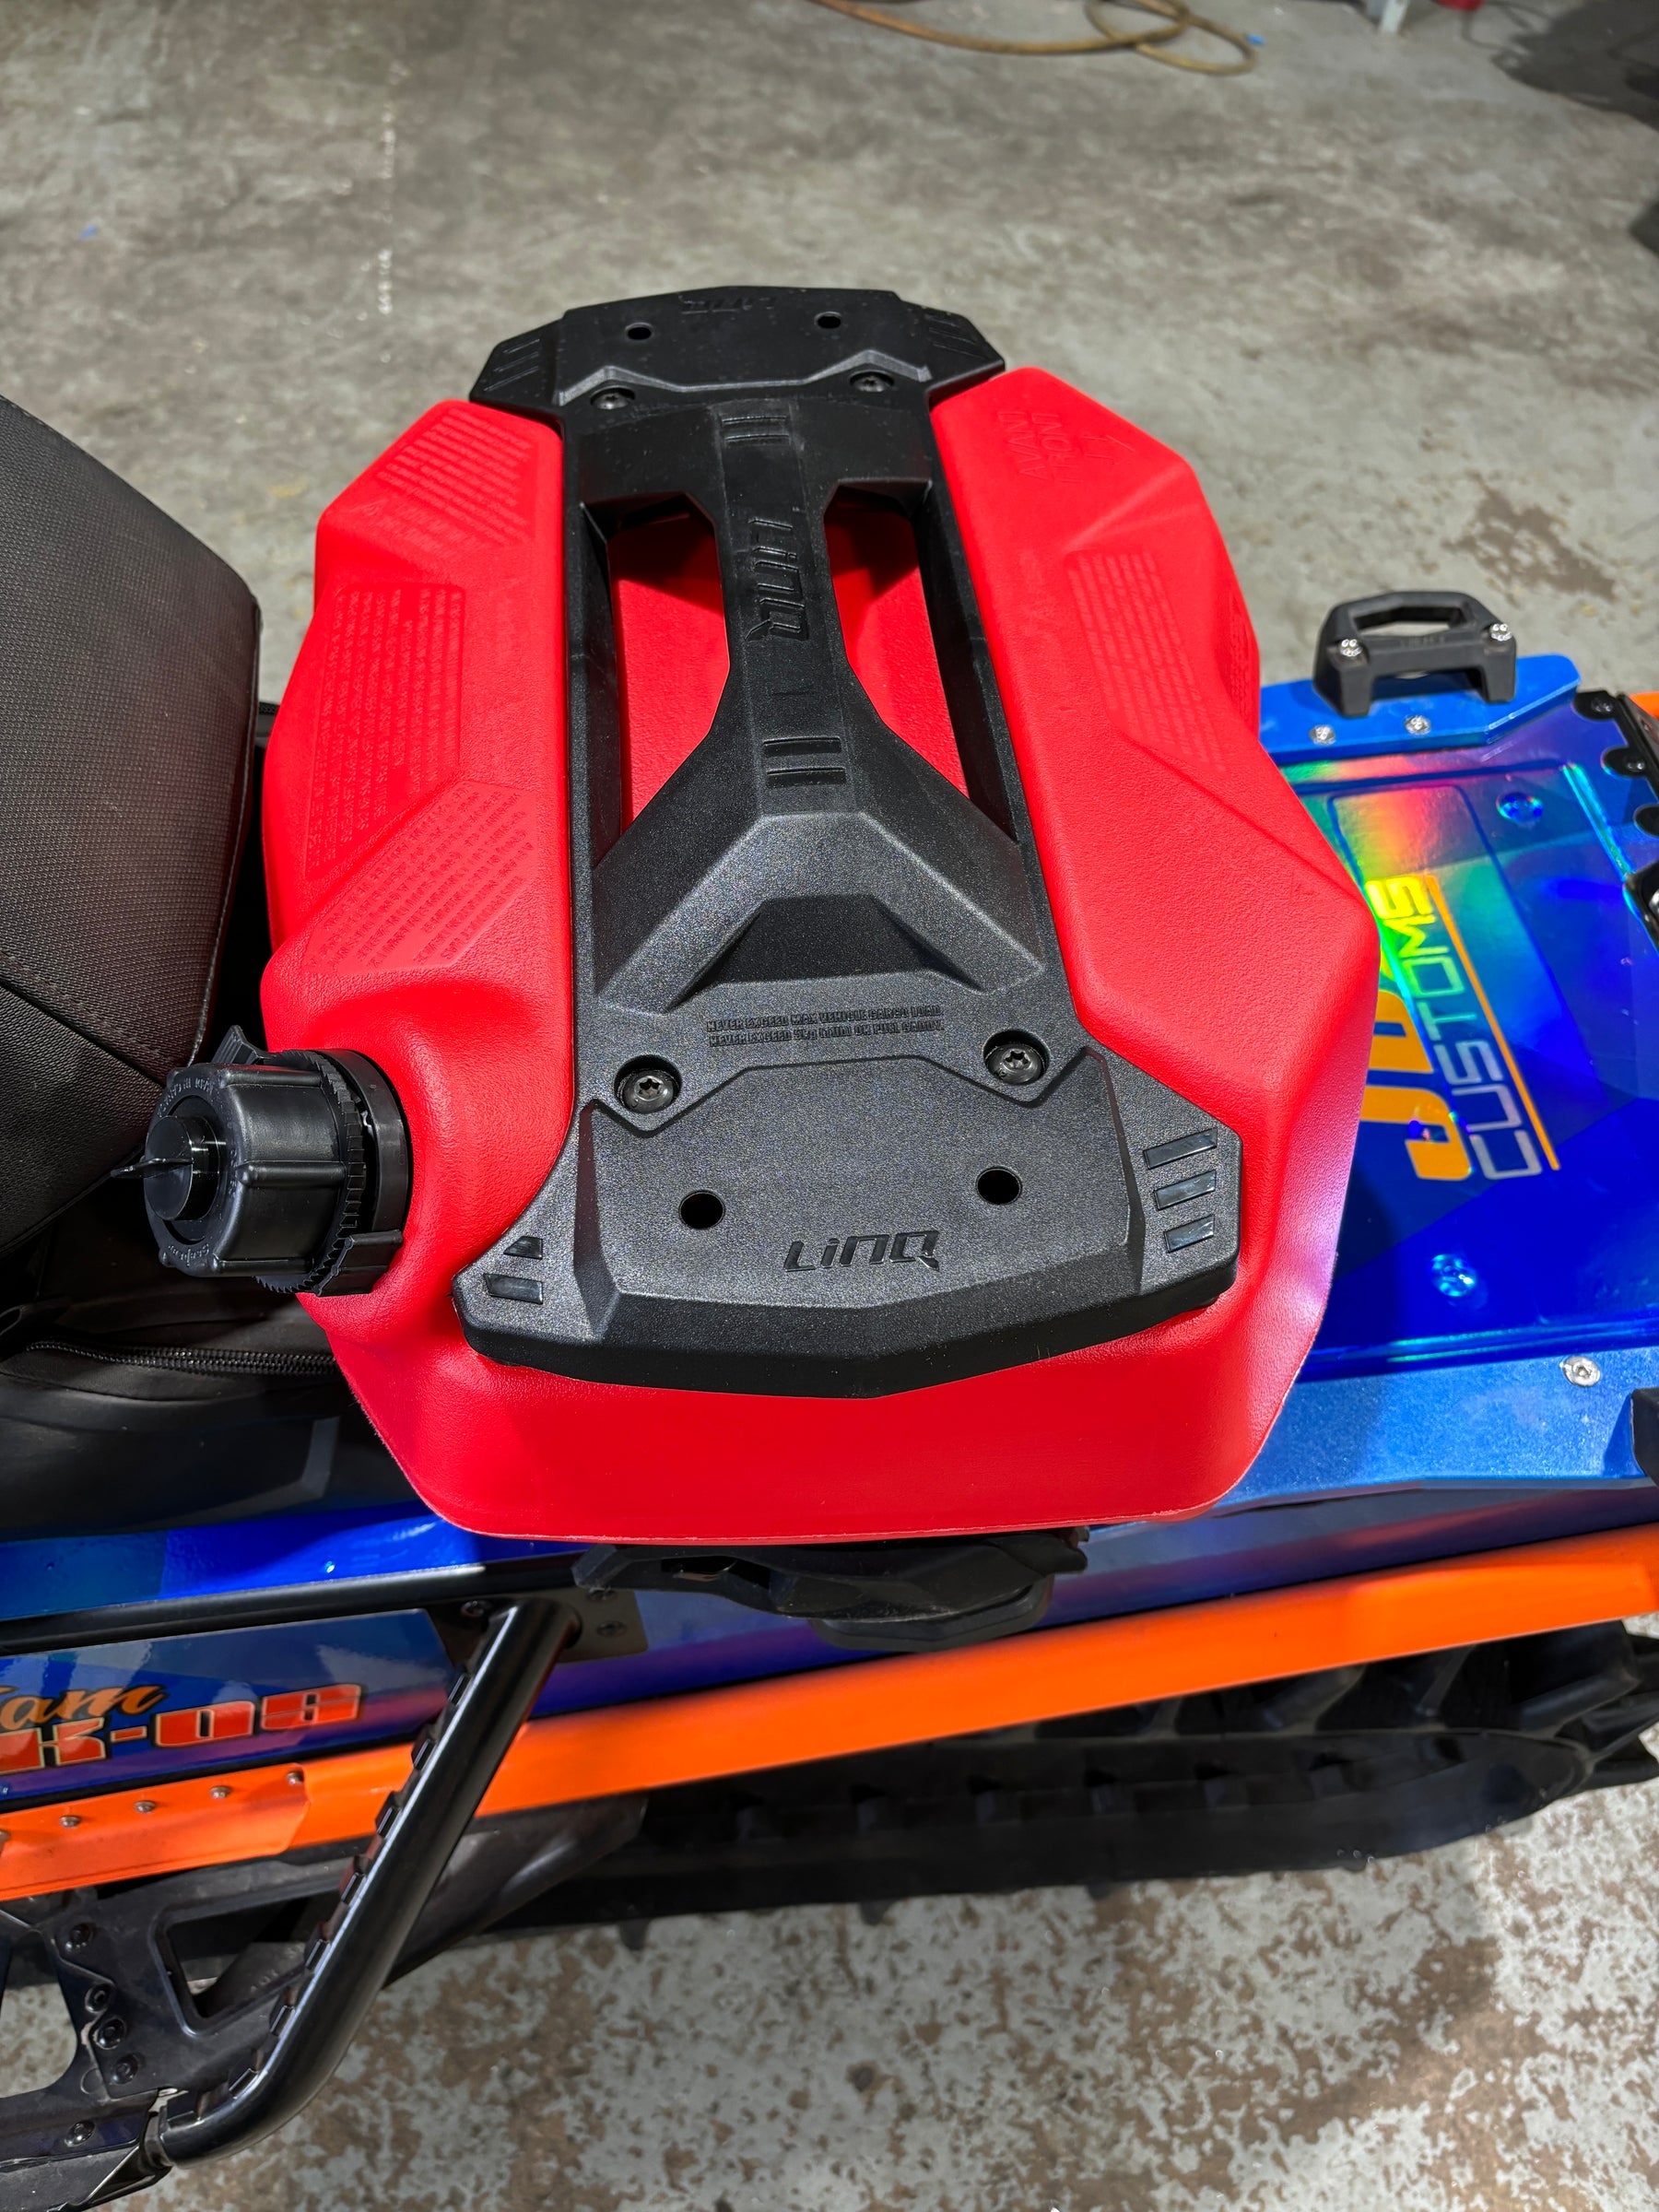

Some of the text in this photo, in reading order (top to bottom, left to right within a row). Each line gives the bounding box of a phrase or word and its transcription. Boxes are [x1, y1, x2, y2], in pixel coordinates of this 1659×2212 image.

[706, 1018, 745, 1032] NEVER
[745, 1015, 789, 1029] EXCEED
[791, 1012, 818, 1025] MAX
[819, 1009, 866, 1023] VEHICLE
[868, 1006, 908, 1020] CARGO
[1365, 876, 1542, 1181] CUSTOMS
[709, 1033, 747, 1047] NEVER
[747, 1030, 793, 1044] EXCEED
[0, 1685, 169, 1731] am
